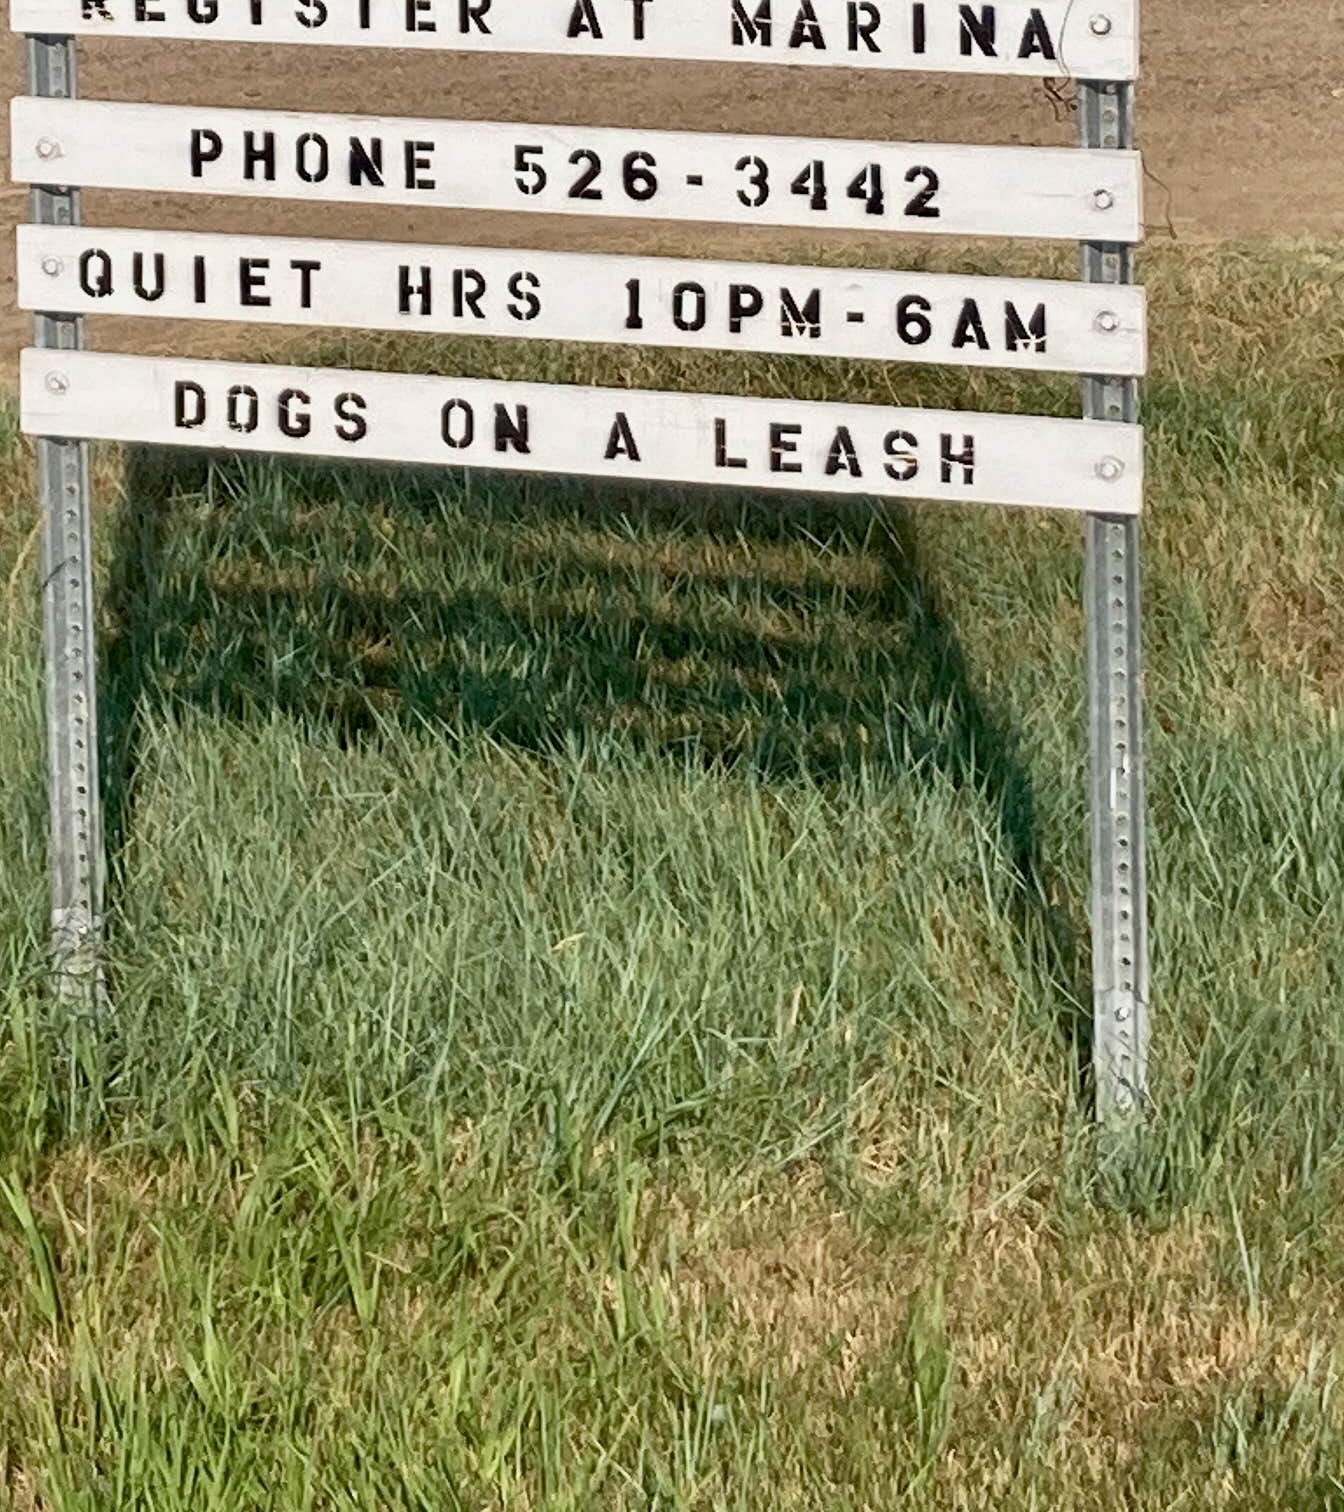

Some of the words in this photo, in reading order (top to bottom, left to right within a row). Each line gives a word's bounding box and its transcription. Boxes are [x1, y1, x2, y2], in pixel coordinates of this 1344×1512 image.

[190, 129, 436, 190] PHONE
[514, 145, 941, 218] 526-3442
[78, 249, 322, 310] QUIET
[398, 265, 541, 321] HRS
[624, 278, 1048, 354] 10PM-6AM
[174, 380, 367, 441] DOGS
[441, 398, 531, 454] ON
[604, 411, 642, 463] A
[714, 418, 977, 486] LEASH
